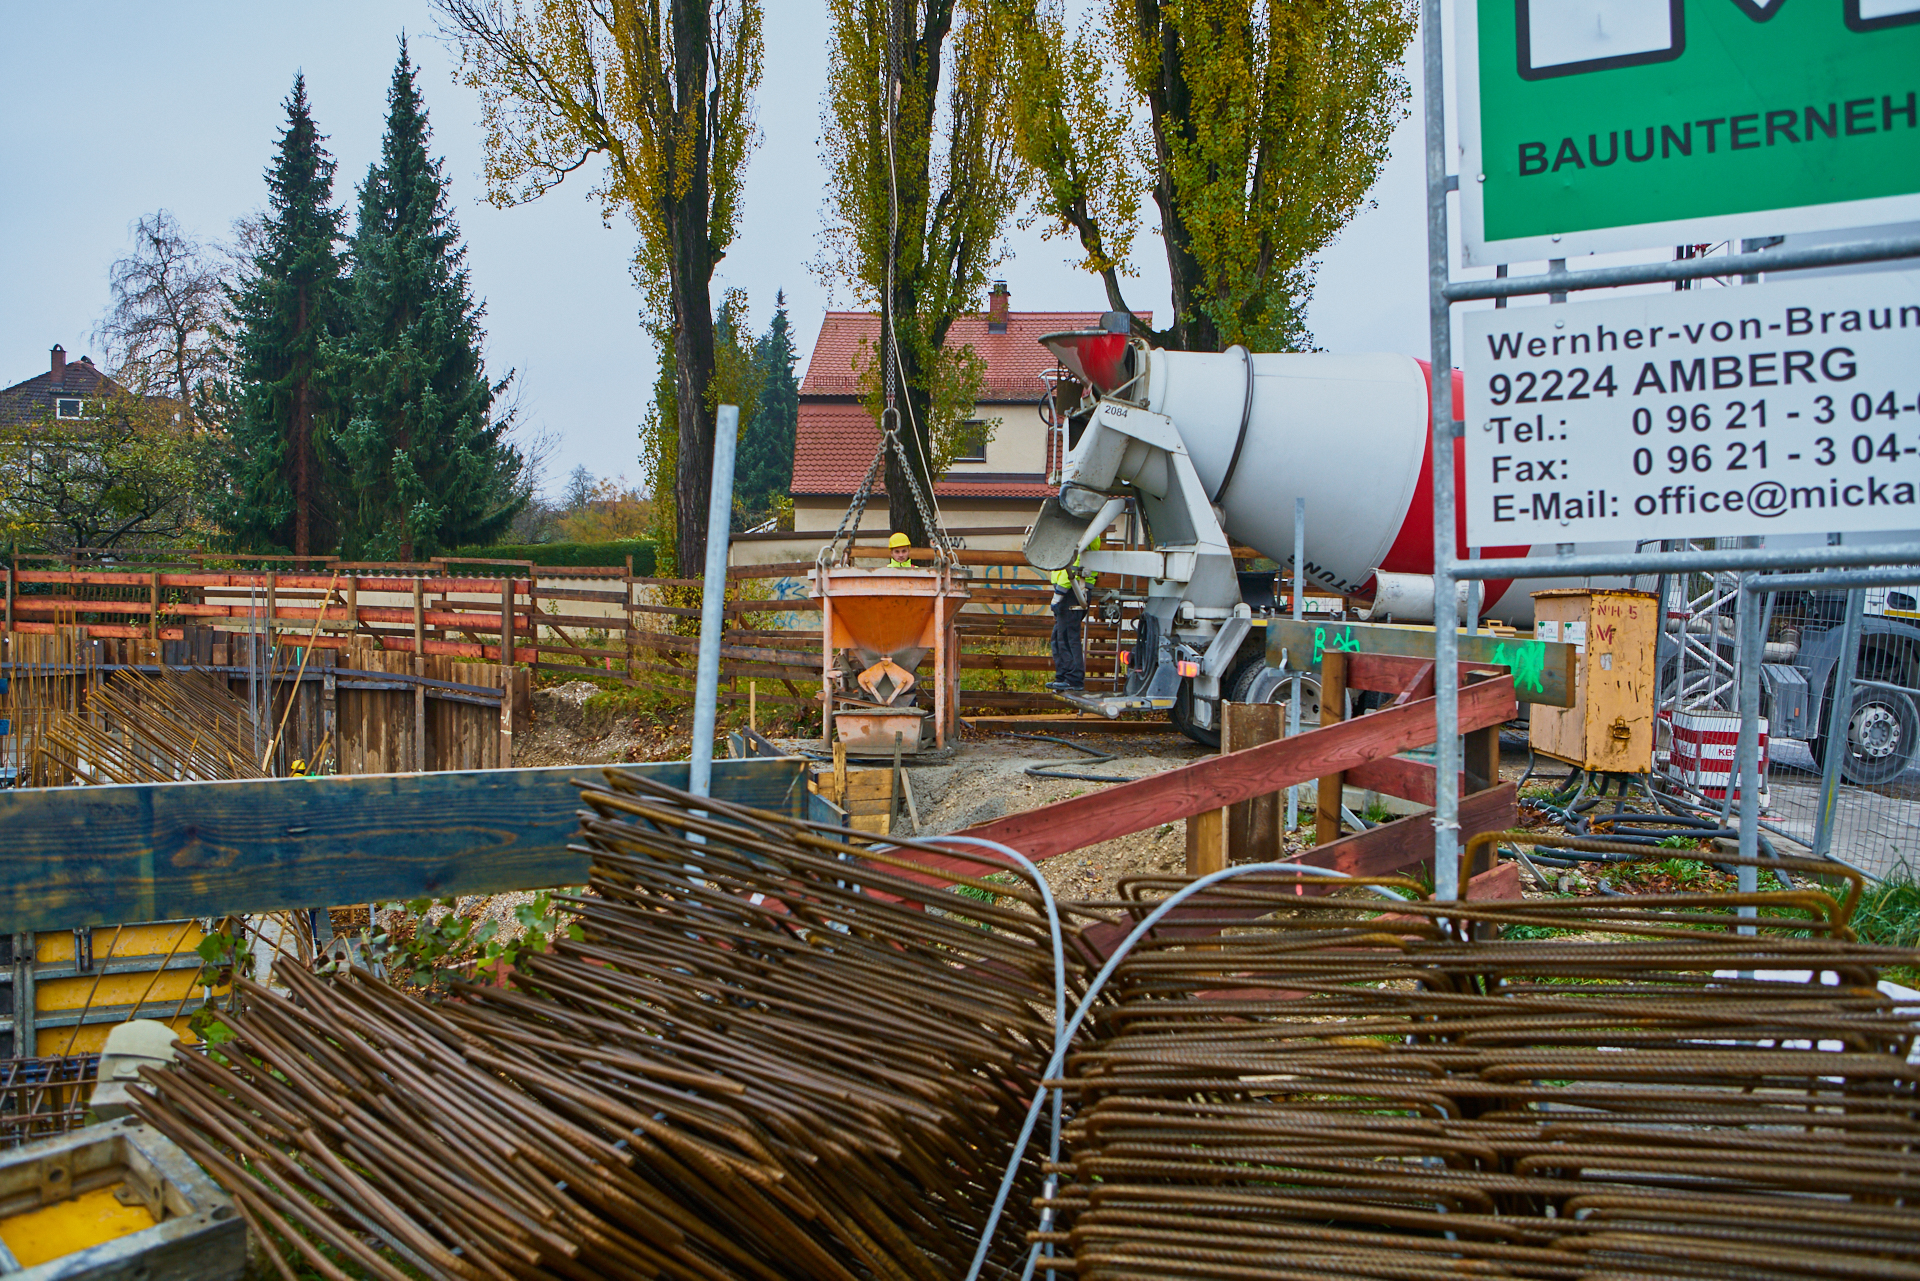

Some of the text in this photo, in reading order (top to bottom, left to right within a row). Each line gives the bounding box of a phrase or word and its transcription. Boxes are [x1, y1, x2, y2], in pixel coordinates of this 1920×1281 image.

[1519, 92, 1917, 176] BAUUNTERNEH
[1490, 347, 1856, 405] 92224 AMBERG
[1105, 404, 1128, 418] 2084
[1490, 415, 1566, 443] Tel.:
[1633, 408, 1651, 435] 0
[1667, 404, 1710, 433] 96
[1726, 400, 1765, 429] 21
[1814, 396, 1834, 424] 3
[1852, 391, 1920, 421] 04-
[1493, 456, 1567, 483] Fax:
[1634, 448, 1652, 475] 0
[1668, 444, 1711, 473] 96
[1727, 441, 1766, 470] 21
[1815, 437, 1835, 465] 3
[1852, 433, 1920, 463] 04-
[1494, 477, 1920, 522] E-Mail: office@micka
